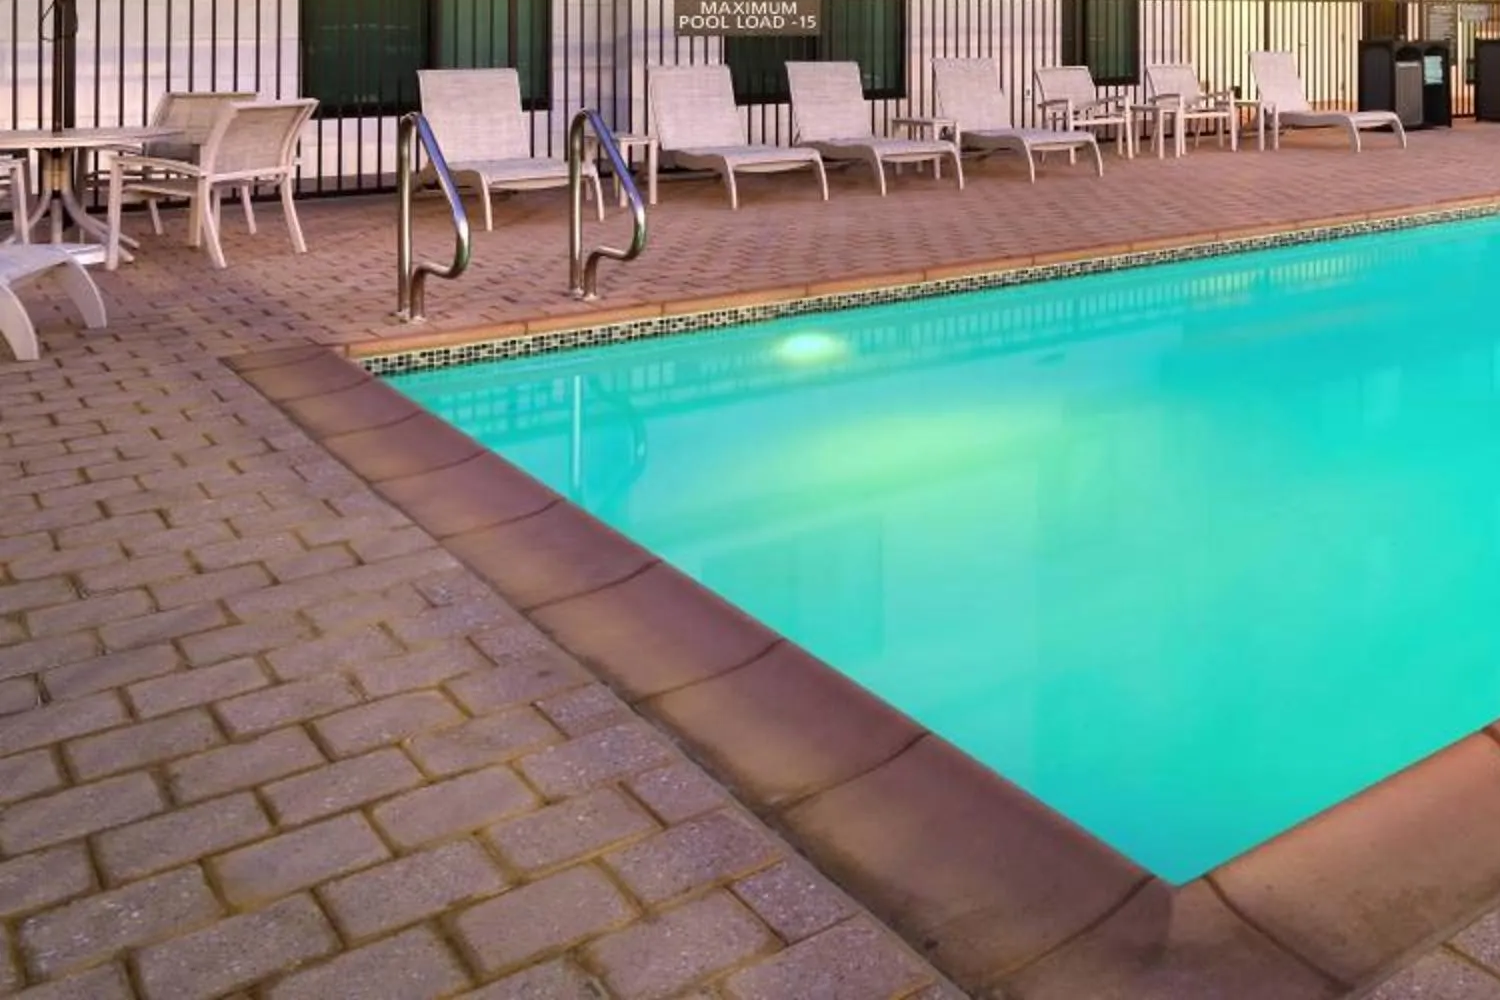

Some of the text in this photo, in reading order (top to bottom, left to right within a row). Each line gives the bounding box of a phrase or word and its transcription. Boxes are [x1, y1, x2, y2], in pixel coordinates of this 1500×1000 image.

[701, 1, 797, 15] MAXIMUM
[679, 15, 730, 29] POOL
[737, 15, 785, 29] LOAD
